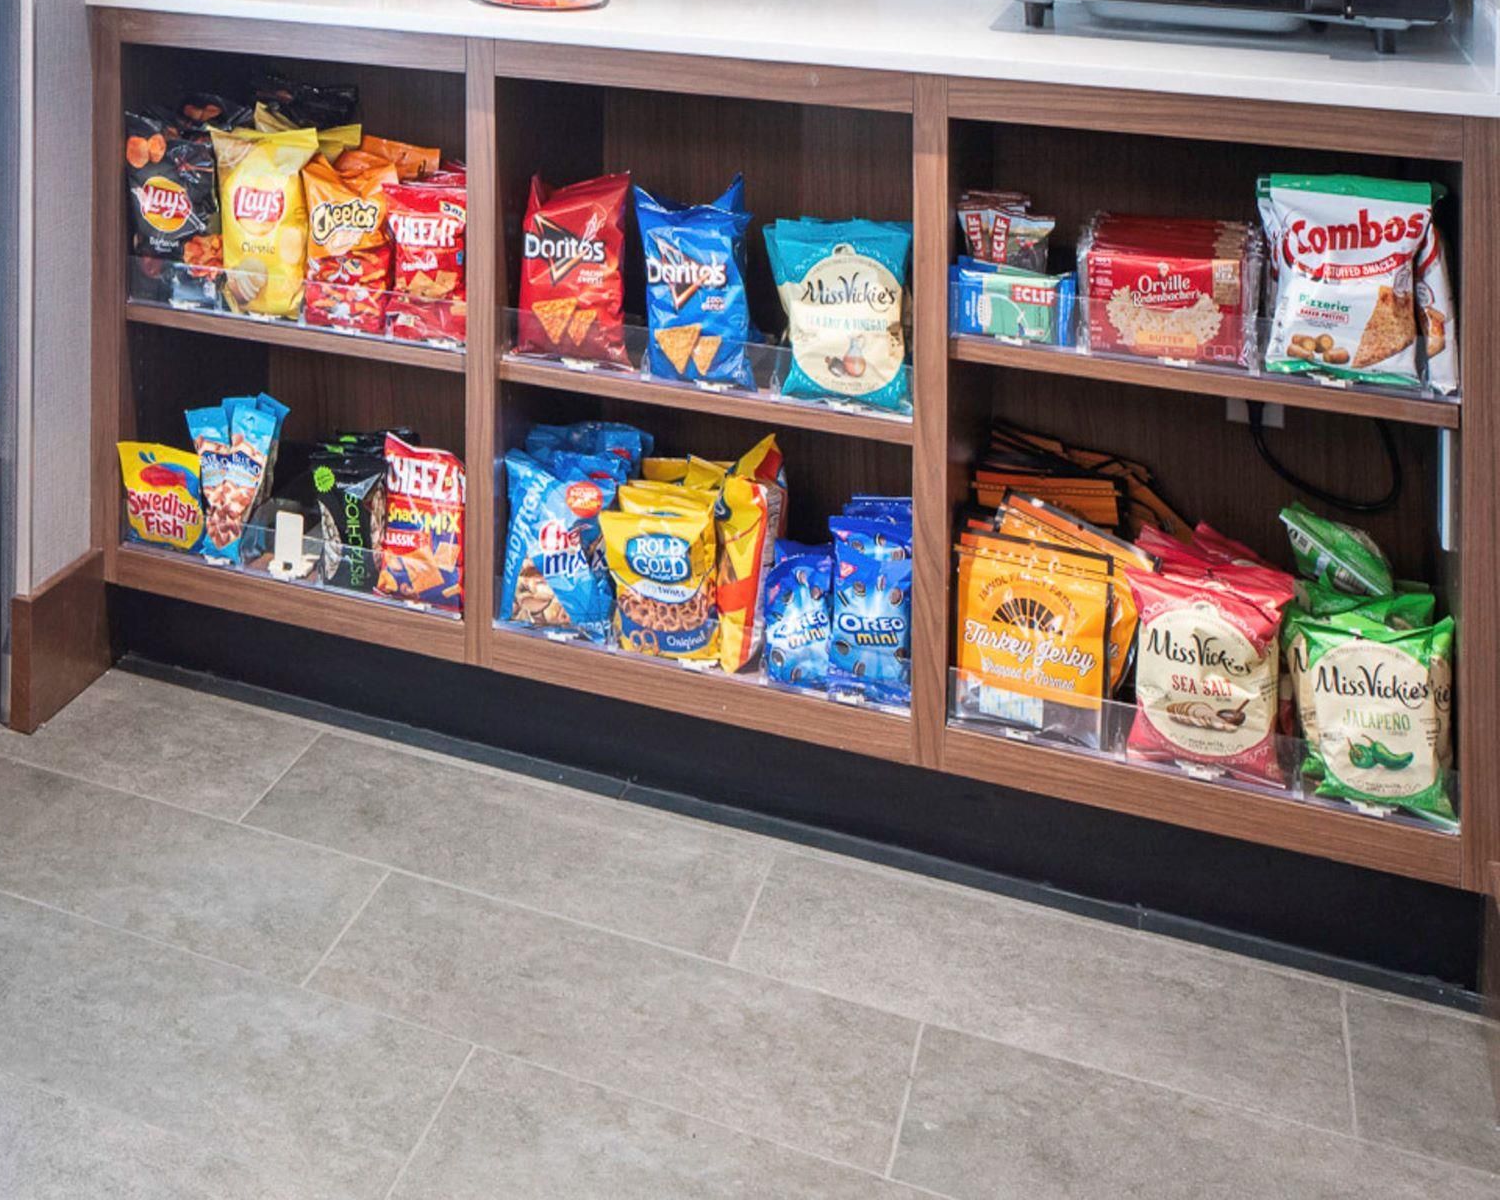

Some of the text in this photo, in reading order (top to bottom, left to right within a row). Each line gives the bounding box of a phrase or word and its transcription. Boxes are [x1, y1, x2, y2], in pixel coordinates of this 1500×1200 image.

[235, 186, 285, 223] Lay's
[312, 199, 379, 244] Cheetos
[1291, 208, 1425, 256] Combos
[525, 233, 605, 263] Doritos
[647, 256, 727, 288] Doritos
[1137, 274, 1191, 294] Orville
[1131, 287, 1202, 307] Redenbacher's
[1148, 334, 1185, 344] BUTTER
[127, 489, 199, 524] Swedish
[140, 511, 187, 541] Fish
[343, 491, 366, 588] PISTACHIOS
[637, 537, 684, 556] ROLD
[633, 556, 689, 580] GOLD
[838, 612, 906, 635] OREO
[666, 634, 707, 650] Original
[855, 629, 899, 649] mini
[964, 618, 1095, 677] Turkey Jerky
[1171, 674, 1234, 698] SEA SALT
[1341, 709, 1411, 732] JALAPEÑO
